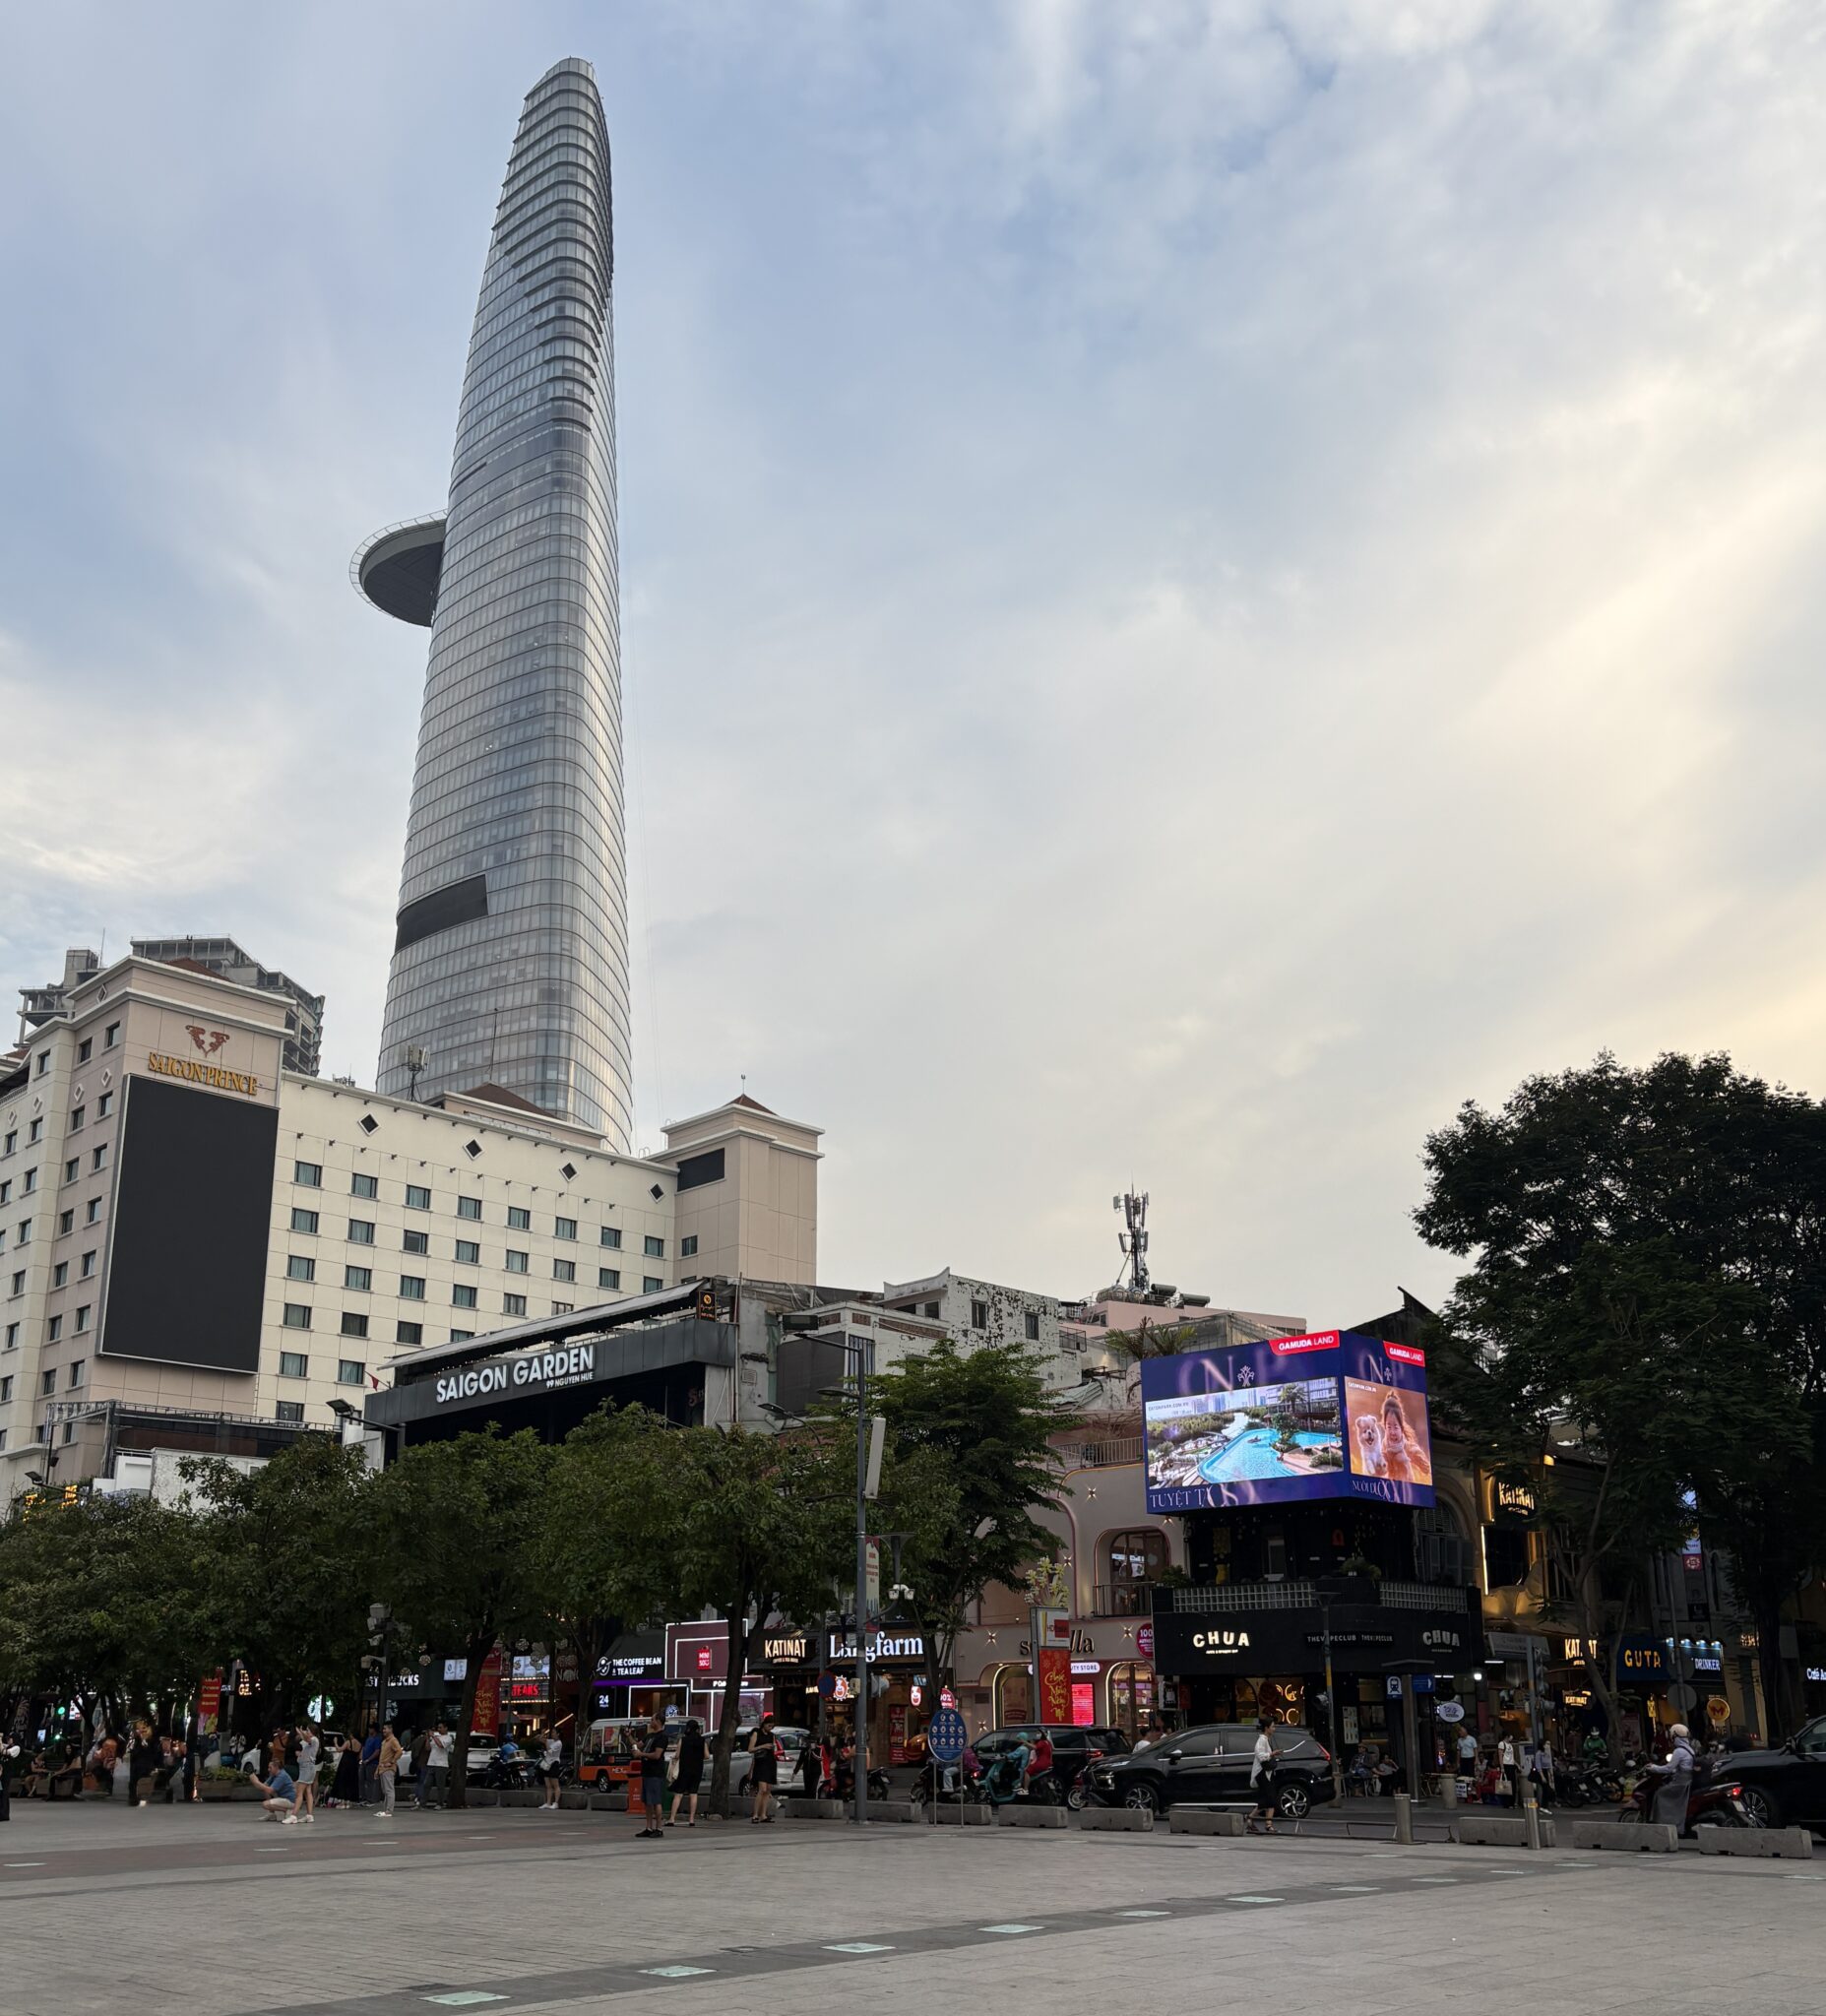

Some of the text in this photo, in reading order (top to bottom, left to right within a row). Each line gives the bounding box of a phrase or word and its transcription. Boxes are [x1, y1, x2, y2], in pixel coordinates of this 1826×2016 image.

[149, 1051, 258, 1096] SAIGON PRINCE
[1278, 1336, 1335, 1351] GAMUDA LAND
[1389, 1347, 1422, 1361] GAMUDA LAND
[436, 1345, 595, 1404] SAIGON GARDEN
[546, 1371, 594, 1389] 99 NGUYEN HUE
[1150, 1489, 1191, 1508] TUYỆT
[1192, 1630, 1250, 1648] CHUA
[1422, 1629, 1461, 1647] CHUA
[764, 1639, 806, 1659] KATINAT
[1564, 1638, 1598, 1661] KATT
[623, 1658, 645, 1667] COFFEE
[646, 1657, 662, 1666] BEAN
[1624, 1649, 1662, 1669] GUTA
[598, 1695, 609, 1704] 24
